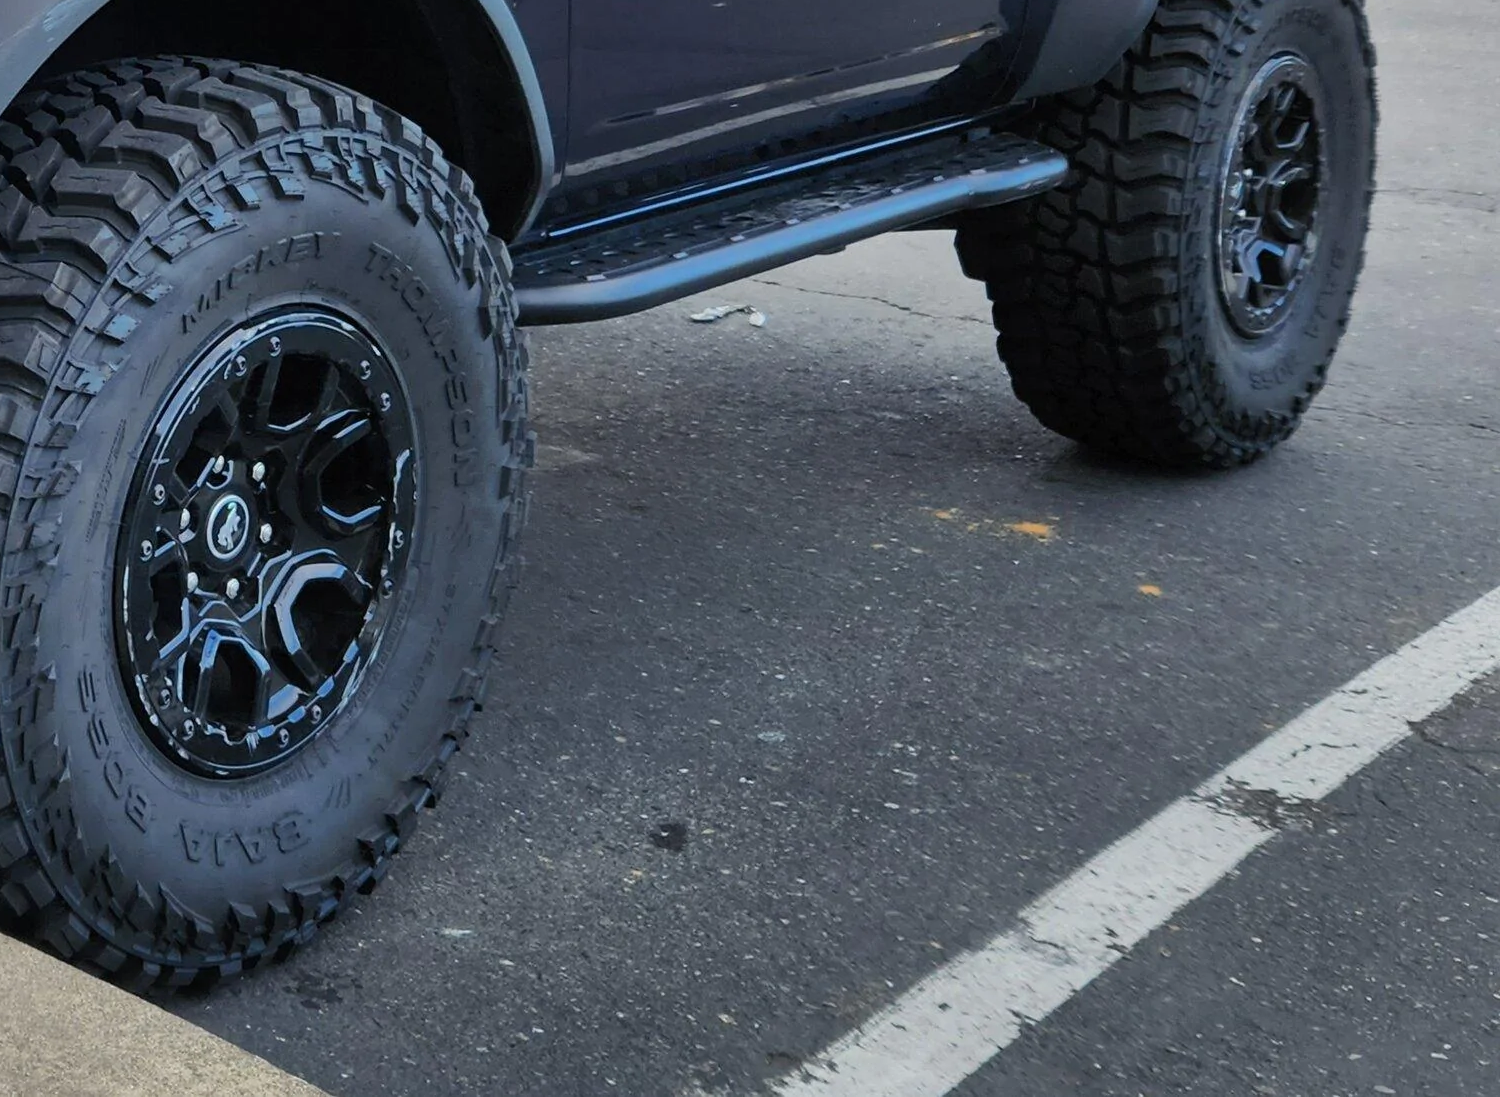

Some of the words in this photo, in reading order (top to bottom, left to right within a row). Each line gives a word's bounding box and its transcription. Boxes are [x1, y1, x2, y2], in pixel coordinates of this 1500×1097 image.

[181, 231, 341, 335] MICKEY
[363, 241, 480, 488] THOMPSON
[77, 665, 152, 835] BOSS
[179, 811, 310, 868] BAJA
